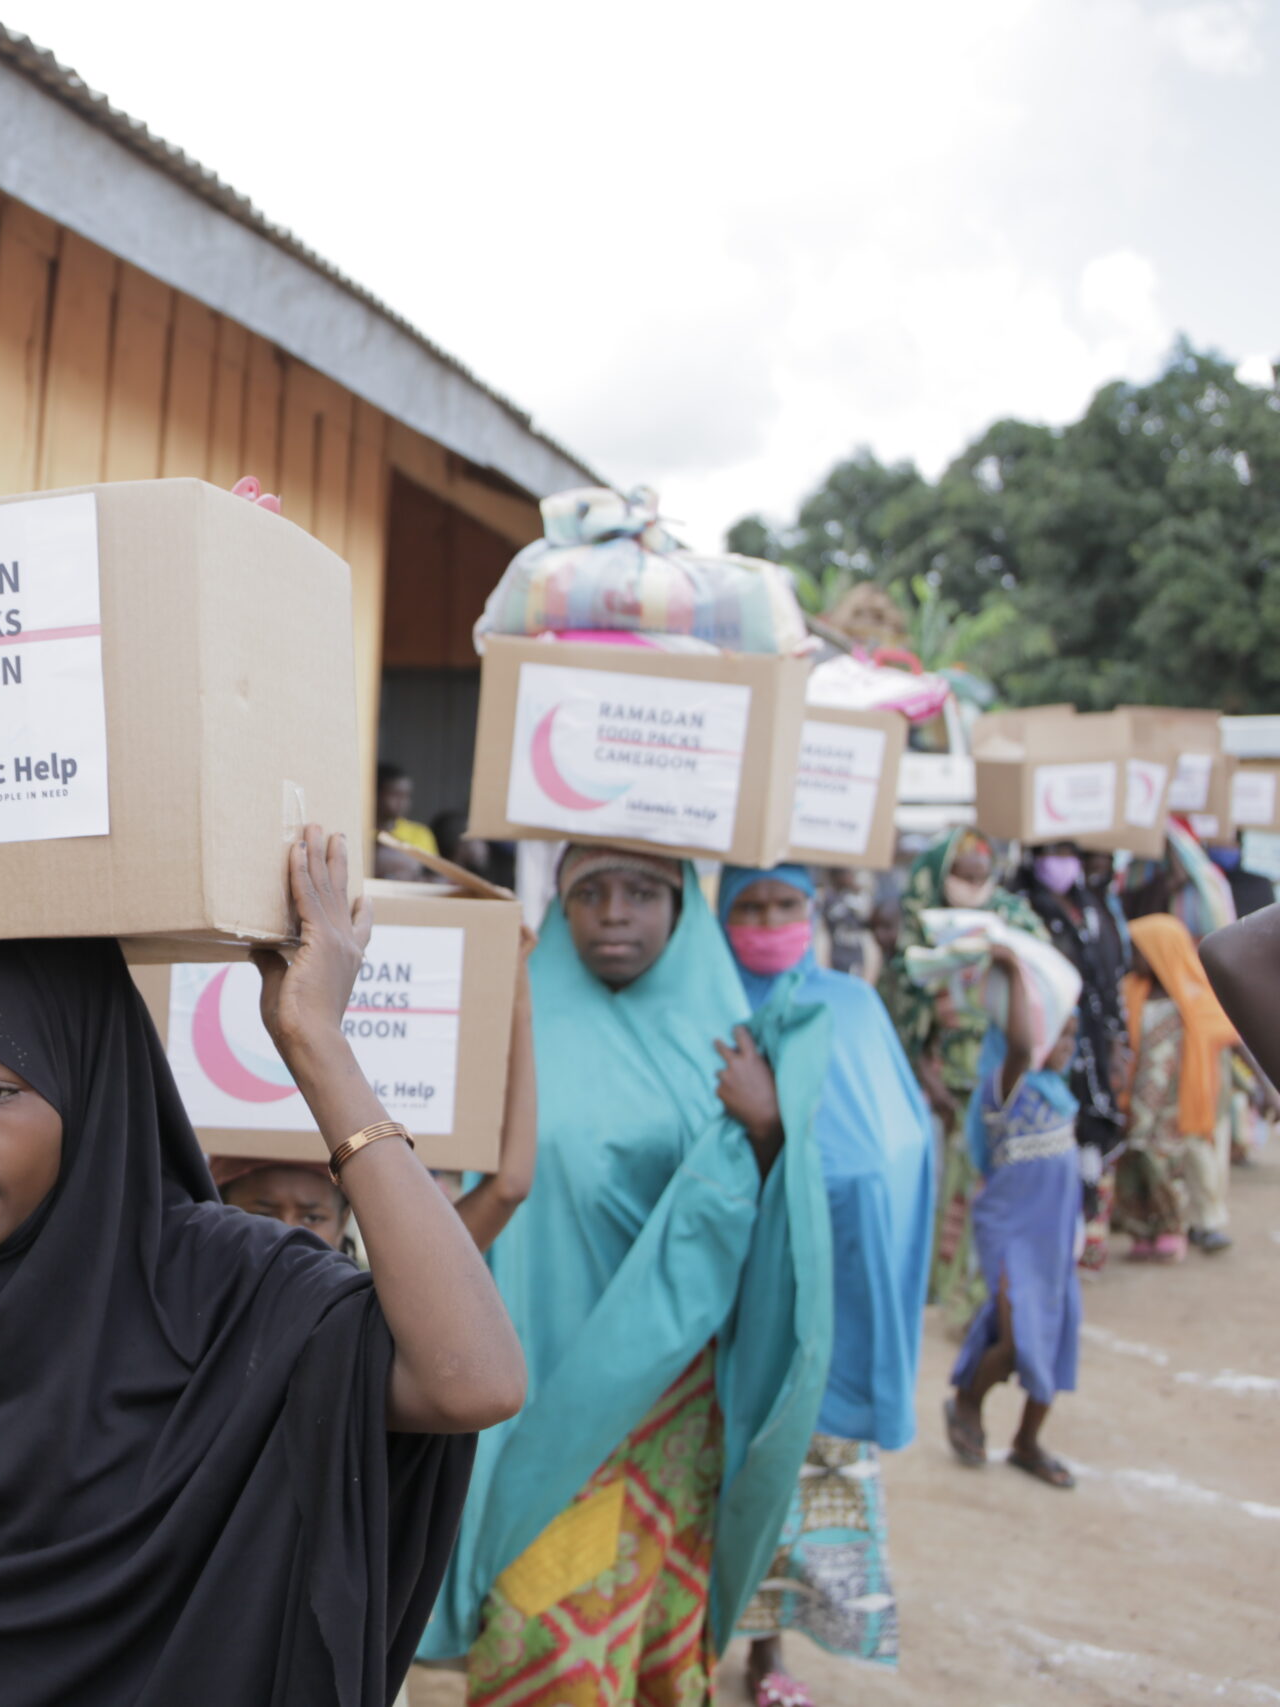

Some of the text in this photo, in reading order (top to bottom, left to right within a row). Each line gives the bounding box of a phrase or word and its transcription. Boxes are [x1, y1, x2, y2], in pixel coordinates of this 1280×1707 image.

[599, 701, 704, 728] RAMADAN
[14, 752, 78, 785] Help
[593, 746, 697, 771] CAMEROON
[26, 791, 37, 799] IN
[41, 788, 69, 798] NEED
[342, 1019, 407, 1038] ROON
[394, 1081, 435, 1101] Help
